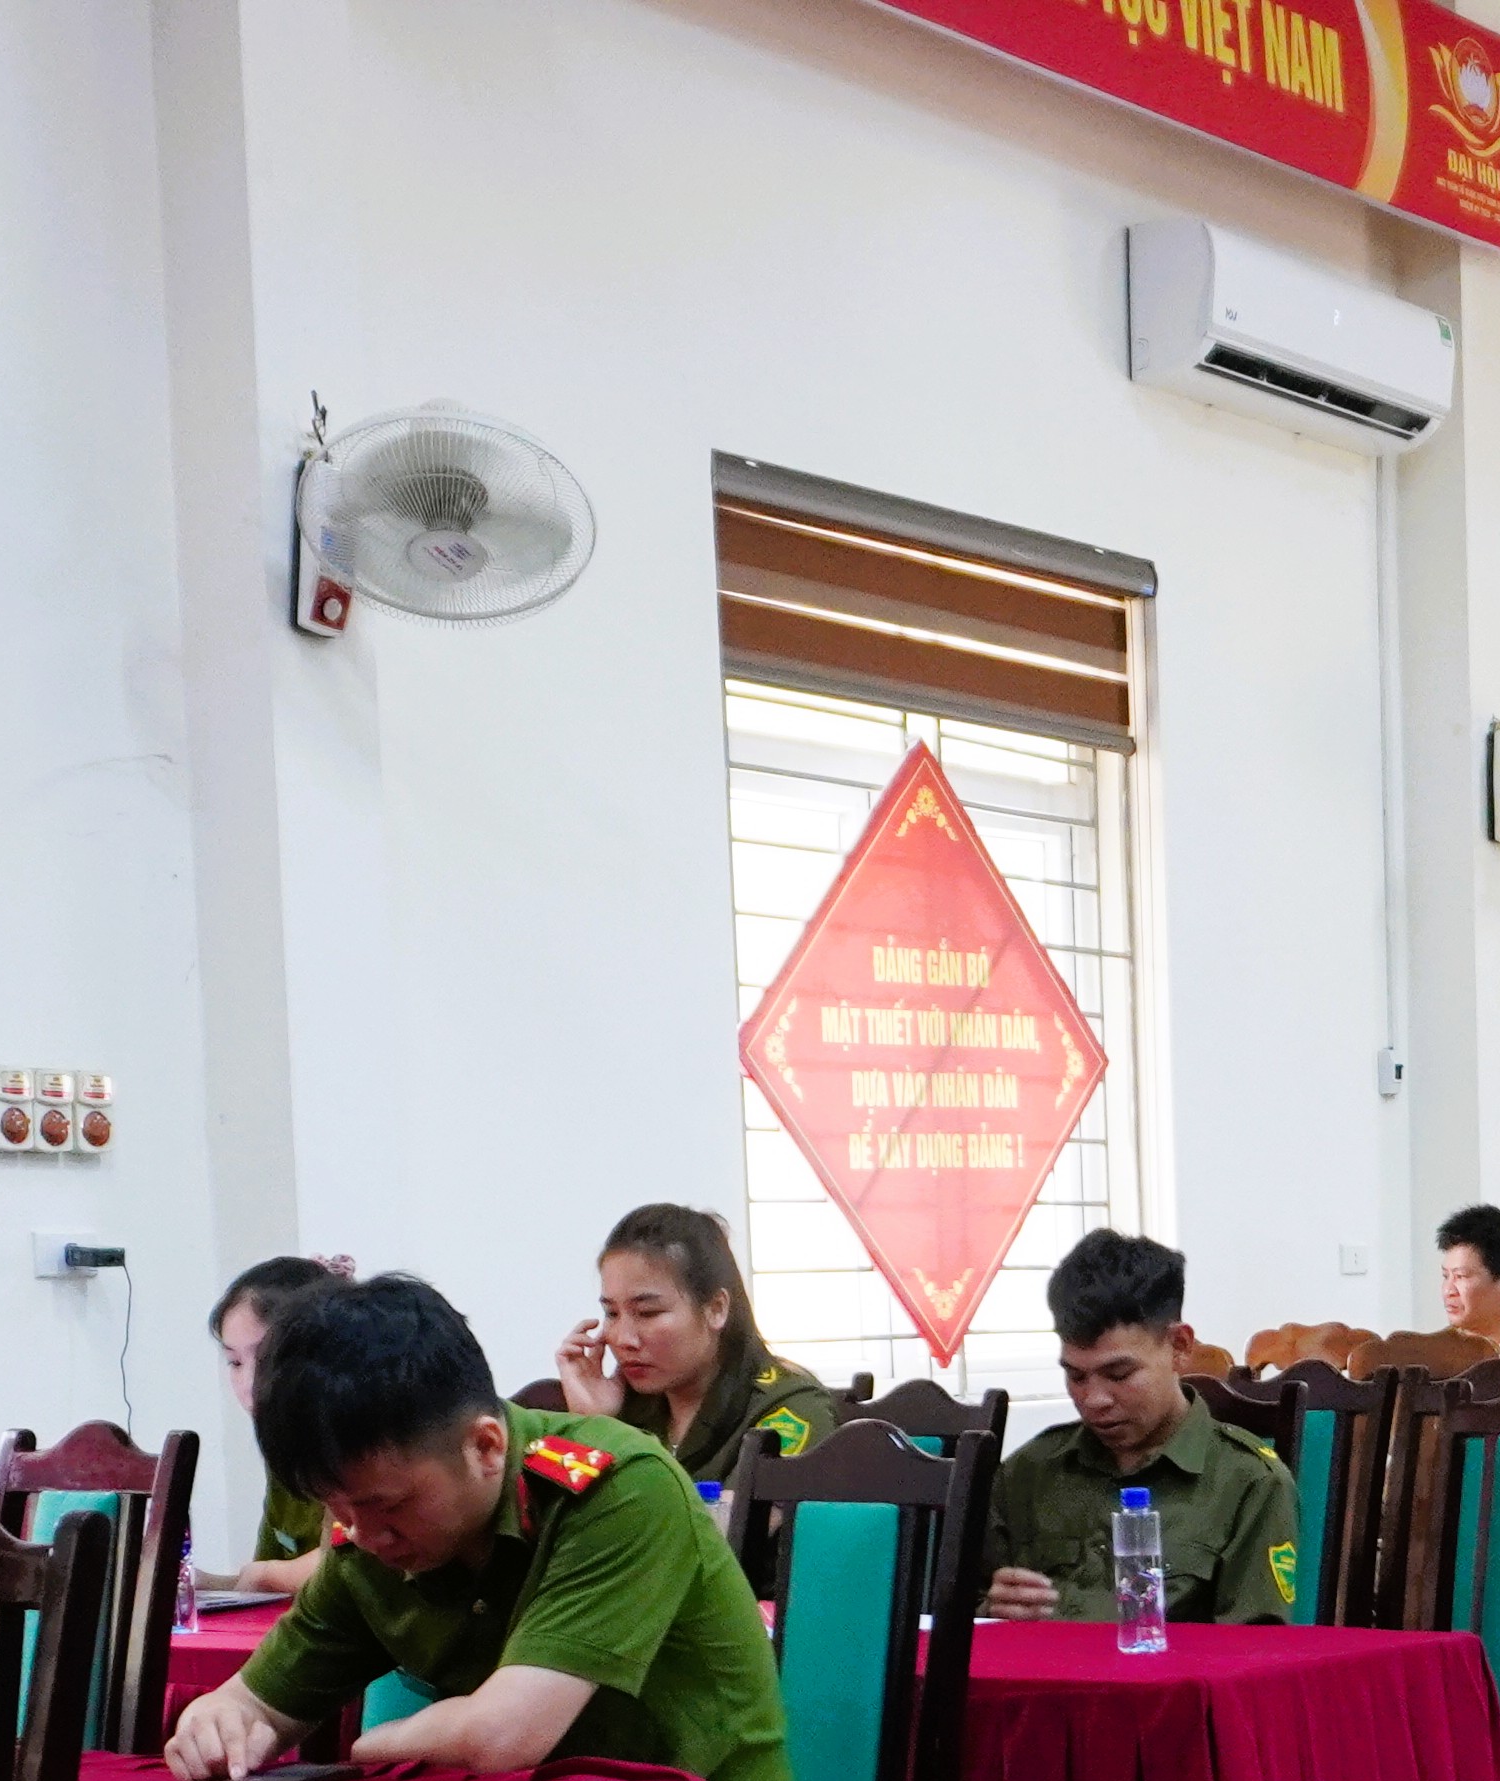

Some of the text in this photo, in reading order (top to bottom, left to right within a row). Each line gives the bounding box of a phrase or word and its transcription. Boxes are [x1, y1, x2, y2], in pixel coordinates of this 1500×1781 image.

[1261, 0, 1344, 113] NAM
[1447, 148, 1474, 181] ĐẠI
[873, 934, 990, 989] ĐẢNG GẮN BÓ
[821, 998, 1041, 1054] MẬT THIẾT VỚI NHÂN DÂN,
[851, 1064, 1018, 1115] DỰA VÀO NHÂN DÂN
[849, 1119, 874, 1170] ĐỂ
[877, 1126, 912, 1169] XÂY
[916, 1130, 964, 1176] DỰNG
[967, 1122, 1014, 1169] ĐẢNG
